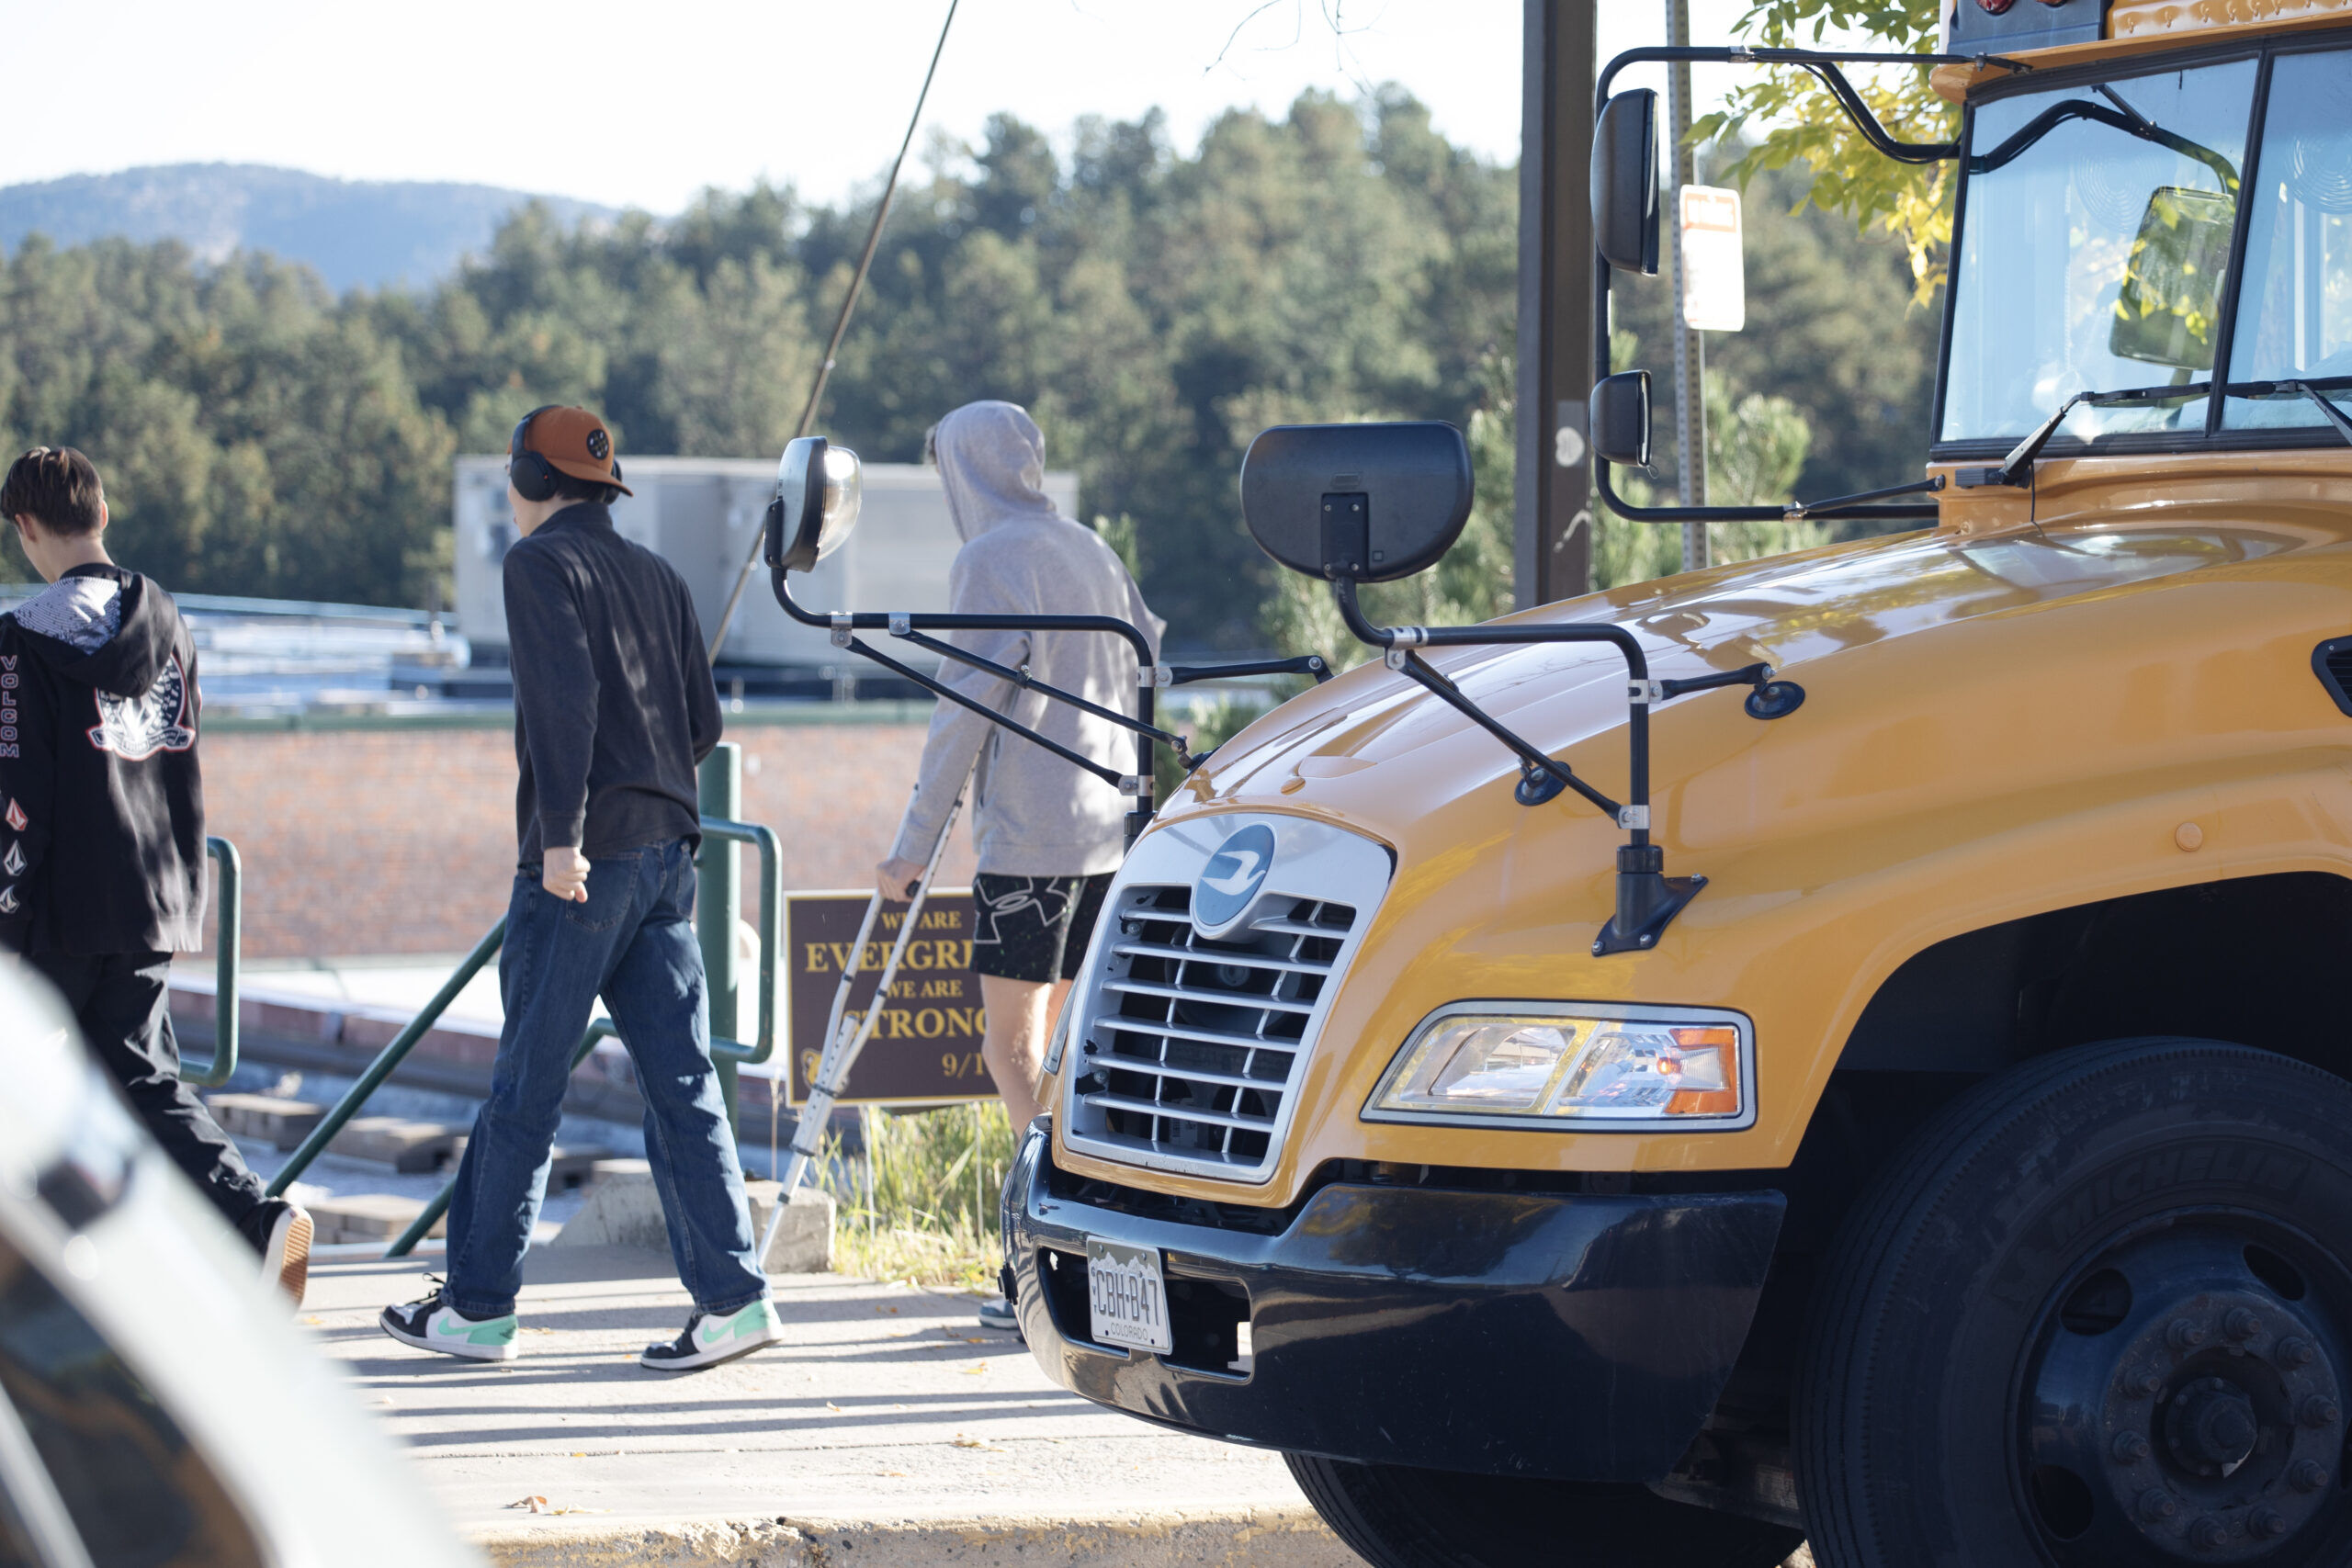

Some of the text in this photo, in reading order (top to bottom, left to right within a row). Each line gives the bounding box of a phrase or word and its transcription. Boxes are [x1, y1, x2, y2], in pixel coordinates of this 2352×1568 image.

[0, 655, 19, 758] VOLCOM
[919, 911, 962, 930] ARE
[920, 979, 962, 998] ARE
[2051, 1146, 2307, 1247] MICHELIN
[1110, 1323, 1148, 1340] COLORADO
